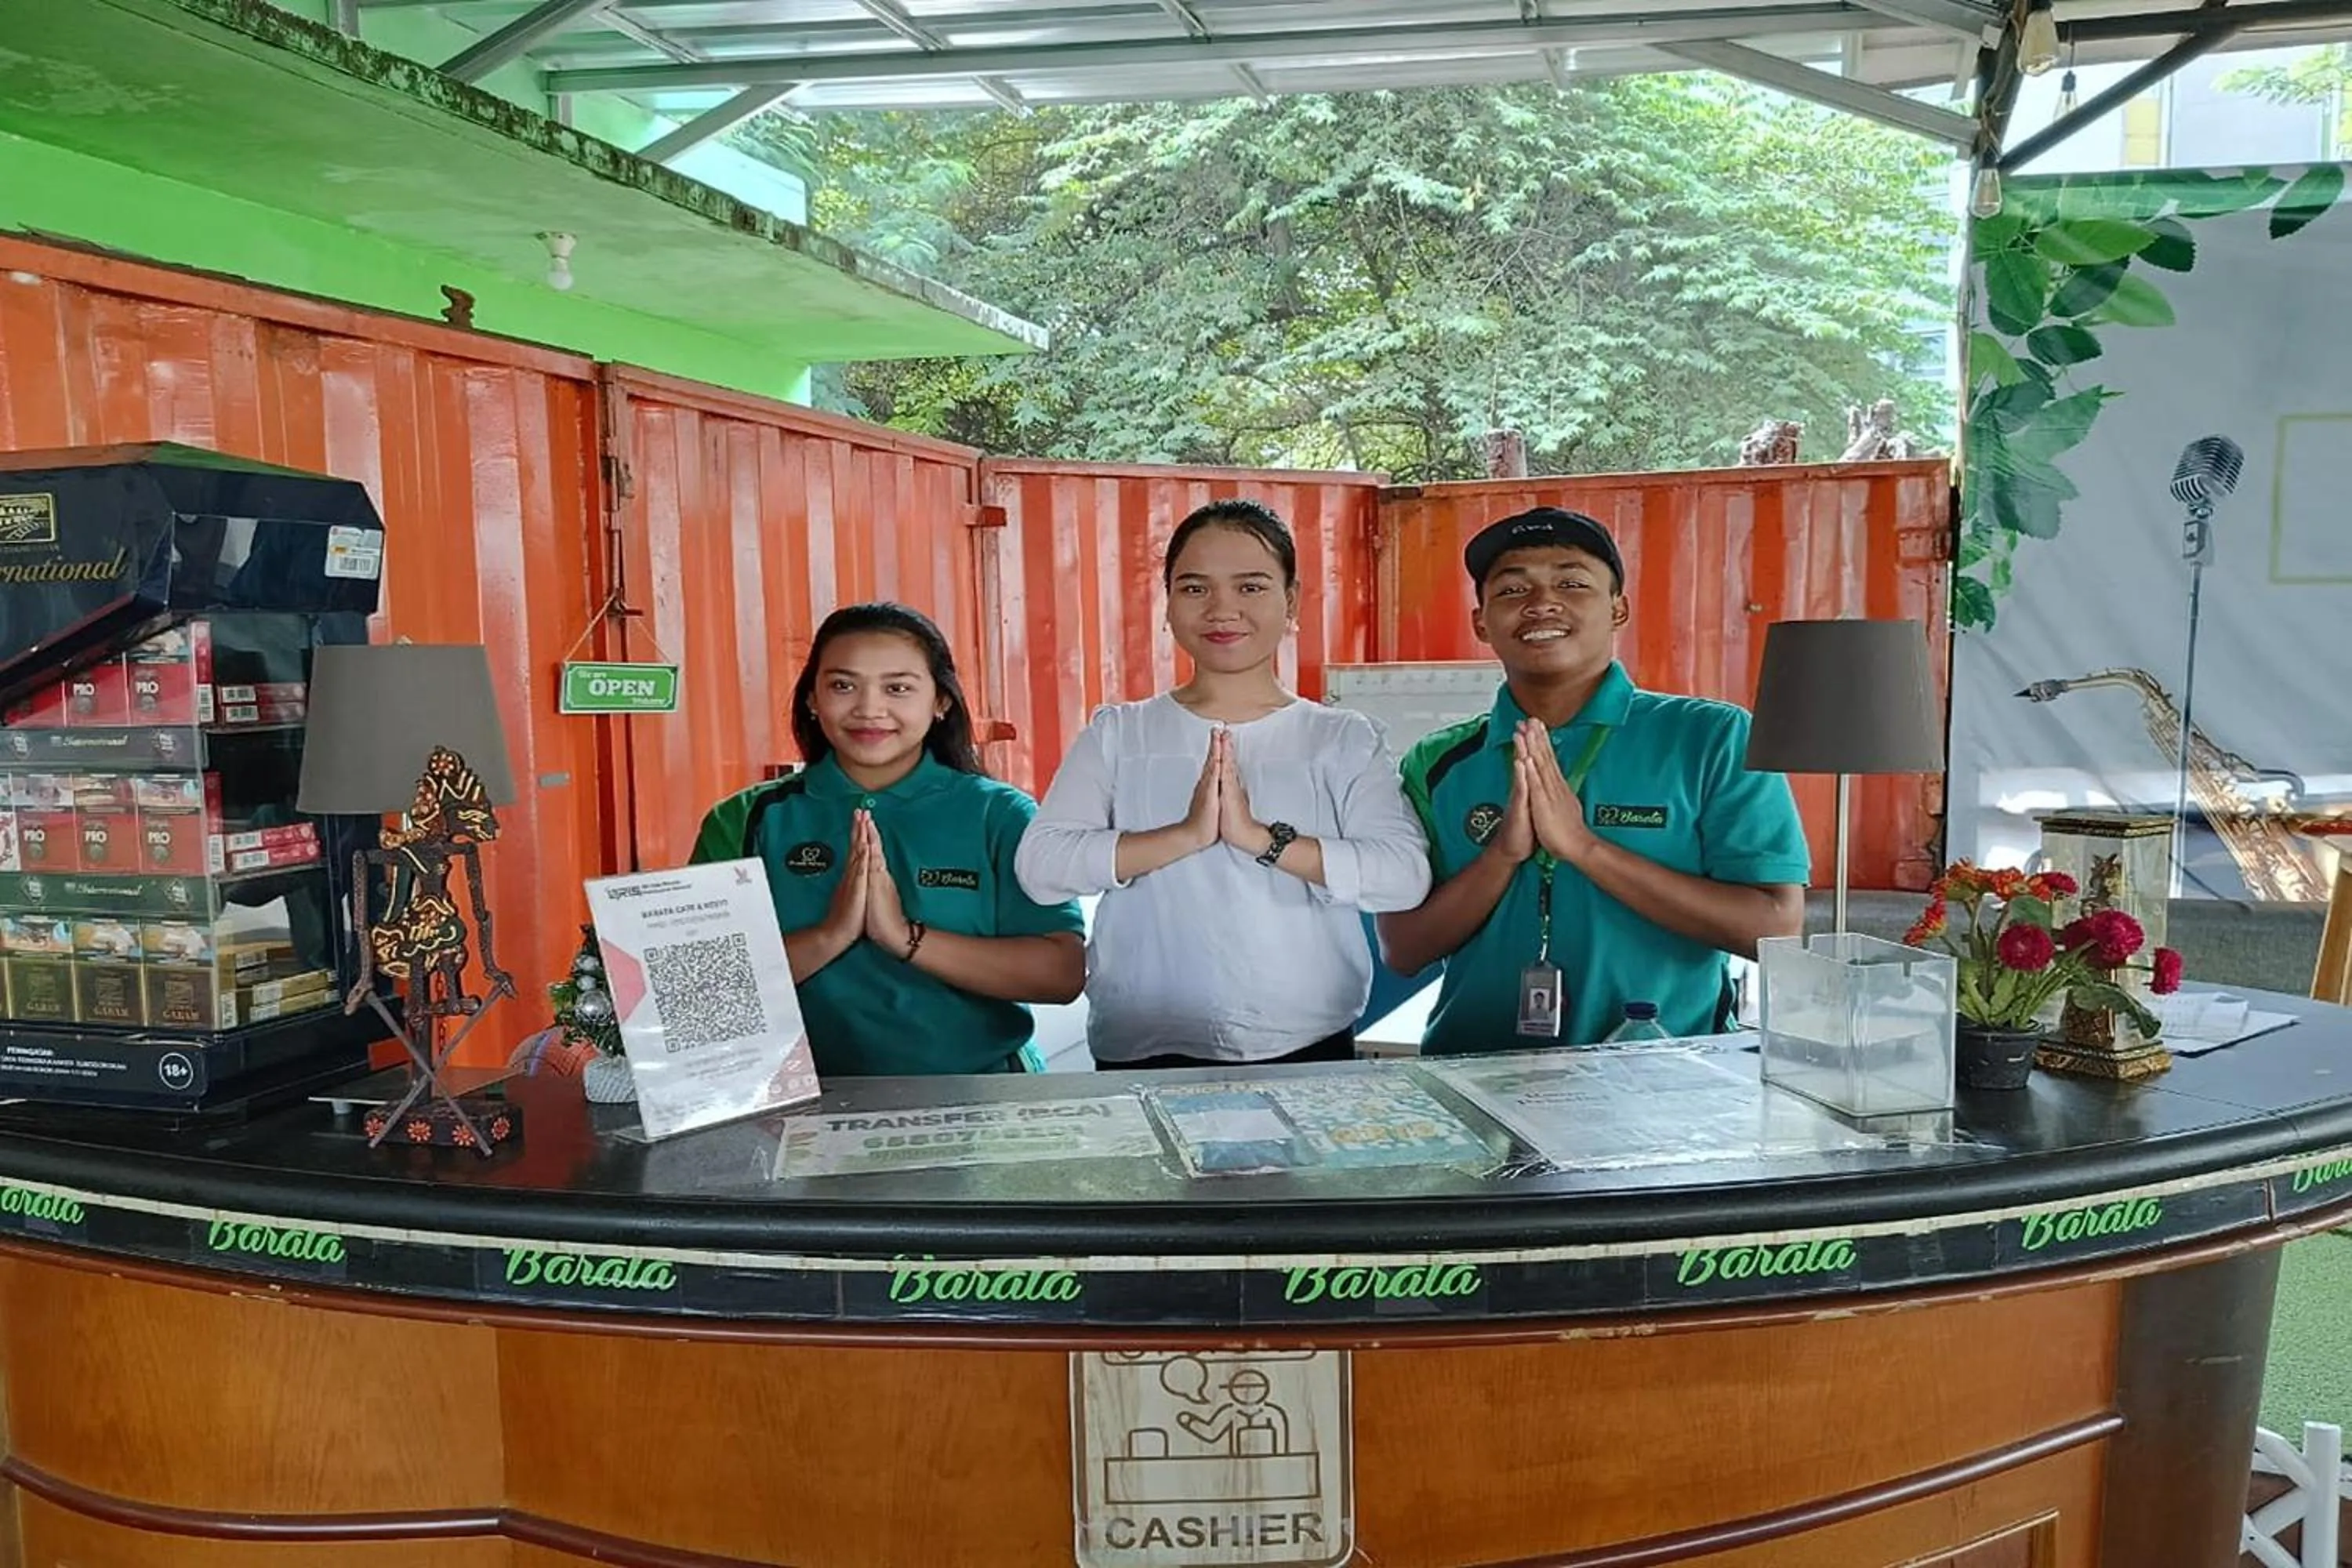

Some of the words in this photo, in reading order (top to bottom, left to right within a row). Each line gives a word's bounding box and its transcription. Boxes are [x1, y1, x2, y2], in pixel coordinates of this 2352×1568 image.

[135, 681, 158, 694] PRO
[589, 678, 655, 696] OPEN
[85, 830, 107, 842] PRO
[147, 831, 170, 844] PRO
[164, 1065, 187, 1077] 18+
[827, 1110, 1007, 1131] TRANSFER
[1, 1185, 85, 1224] arata
[208, 1218, 346, 1263] Barata
[2020, 1196, 2162, 1251] Barata
[502, 1246, 677, 1290] Barata
[888, 1254, 1082, 1303] Barata
[1278, 1258, 1482, 1305] Barata
[1675, 1239, 1857, 1287] Barata
[1104, 1512, 1323, 1548] CASHIER
